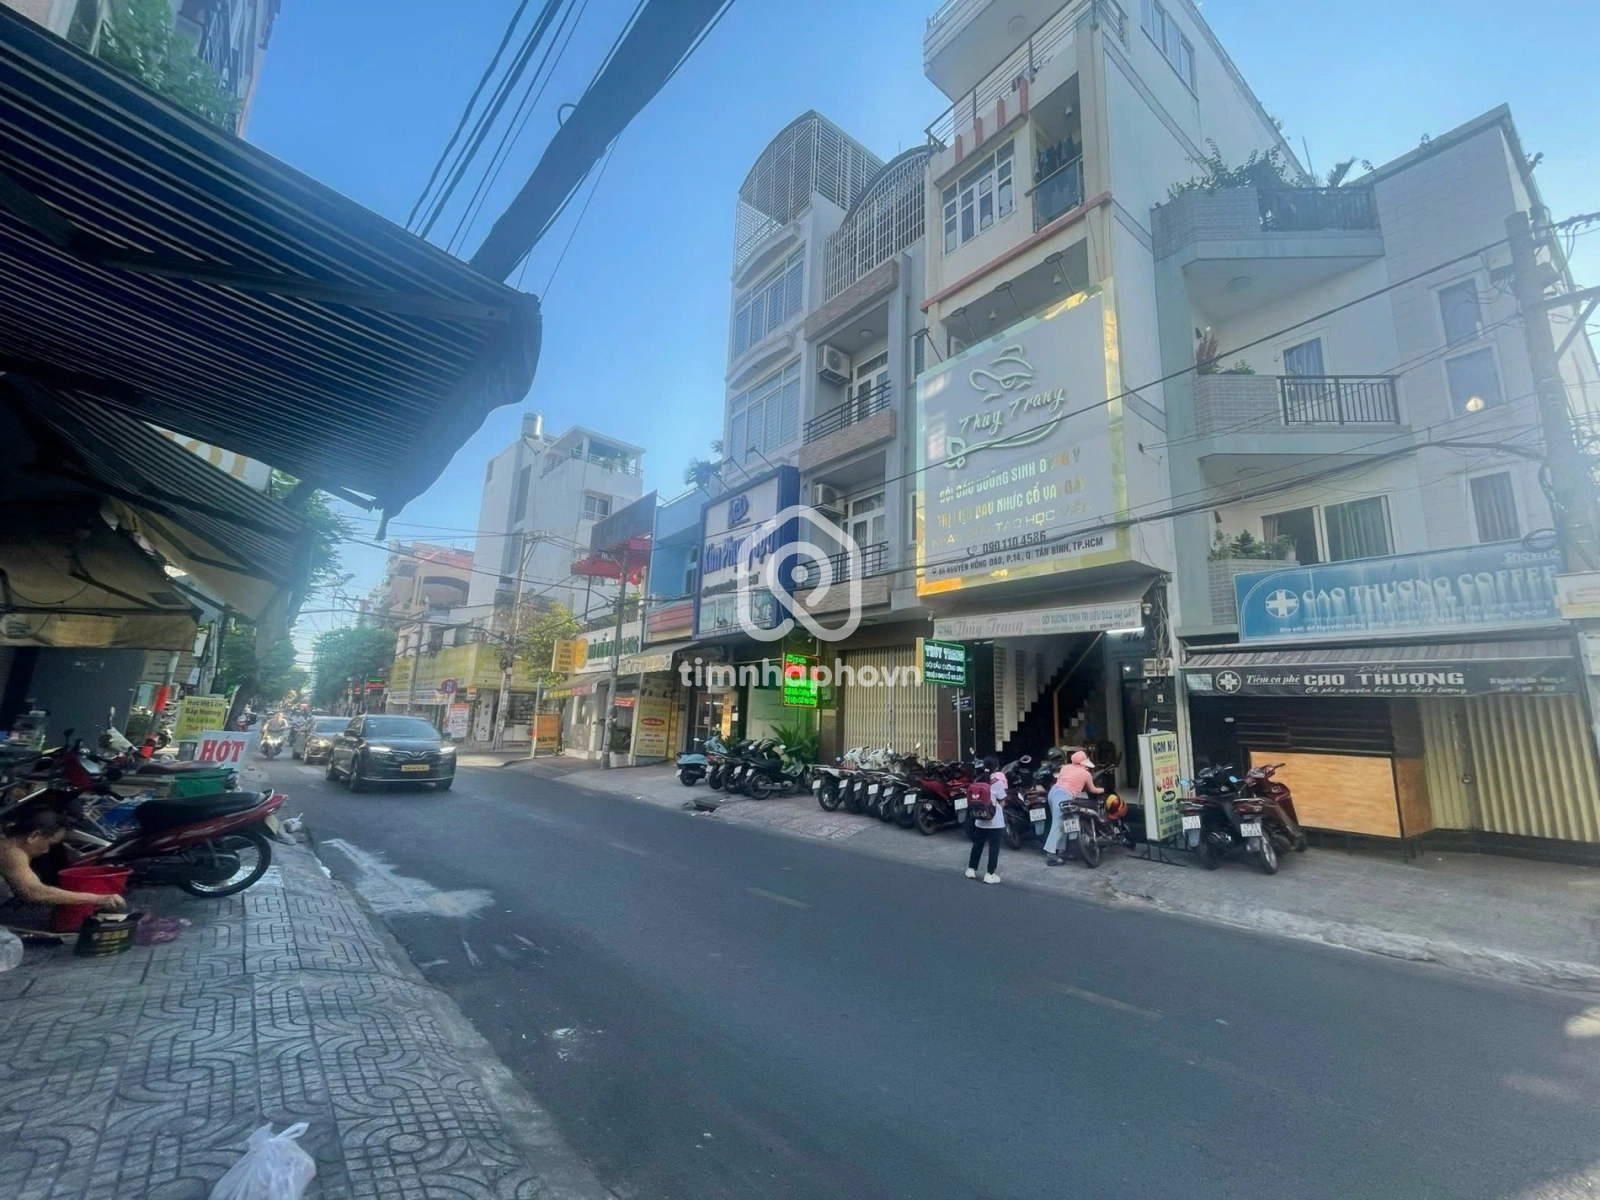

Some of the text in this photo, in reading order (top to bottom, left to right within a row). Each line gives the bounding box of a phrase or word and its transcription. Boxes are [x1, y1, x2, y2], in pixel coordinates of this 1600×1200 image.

[959, 388, 1065, 436] Thùy Trang
[1011, 461, 1036, 482] SINH
[996, 490, 1024, 514] NHỨC
[1025, 509, 1056, 527] HỌC
[1073, 536, 1104, 551] TP.HCM
[1303, 674, 1346, 686] CAO
